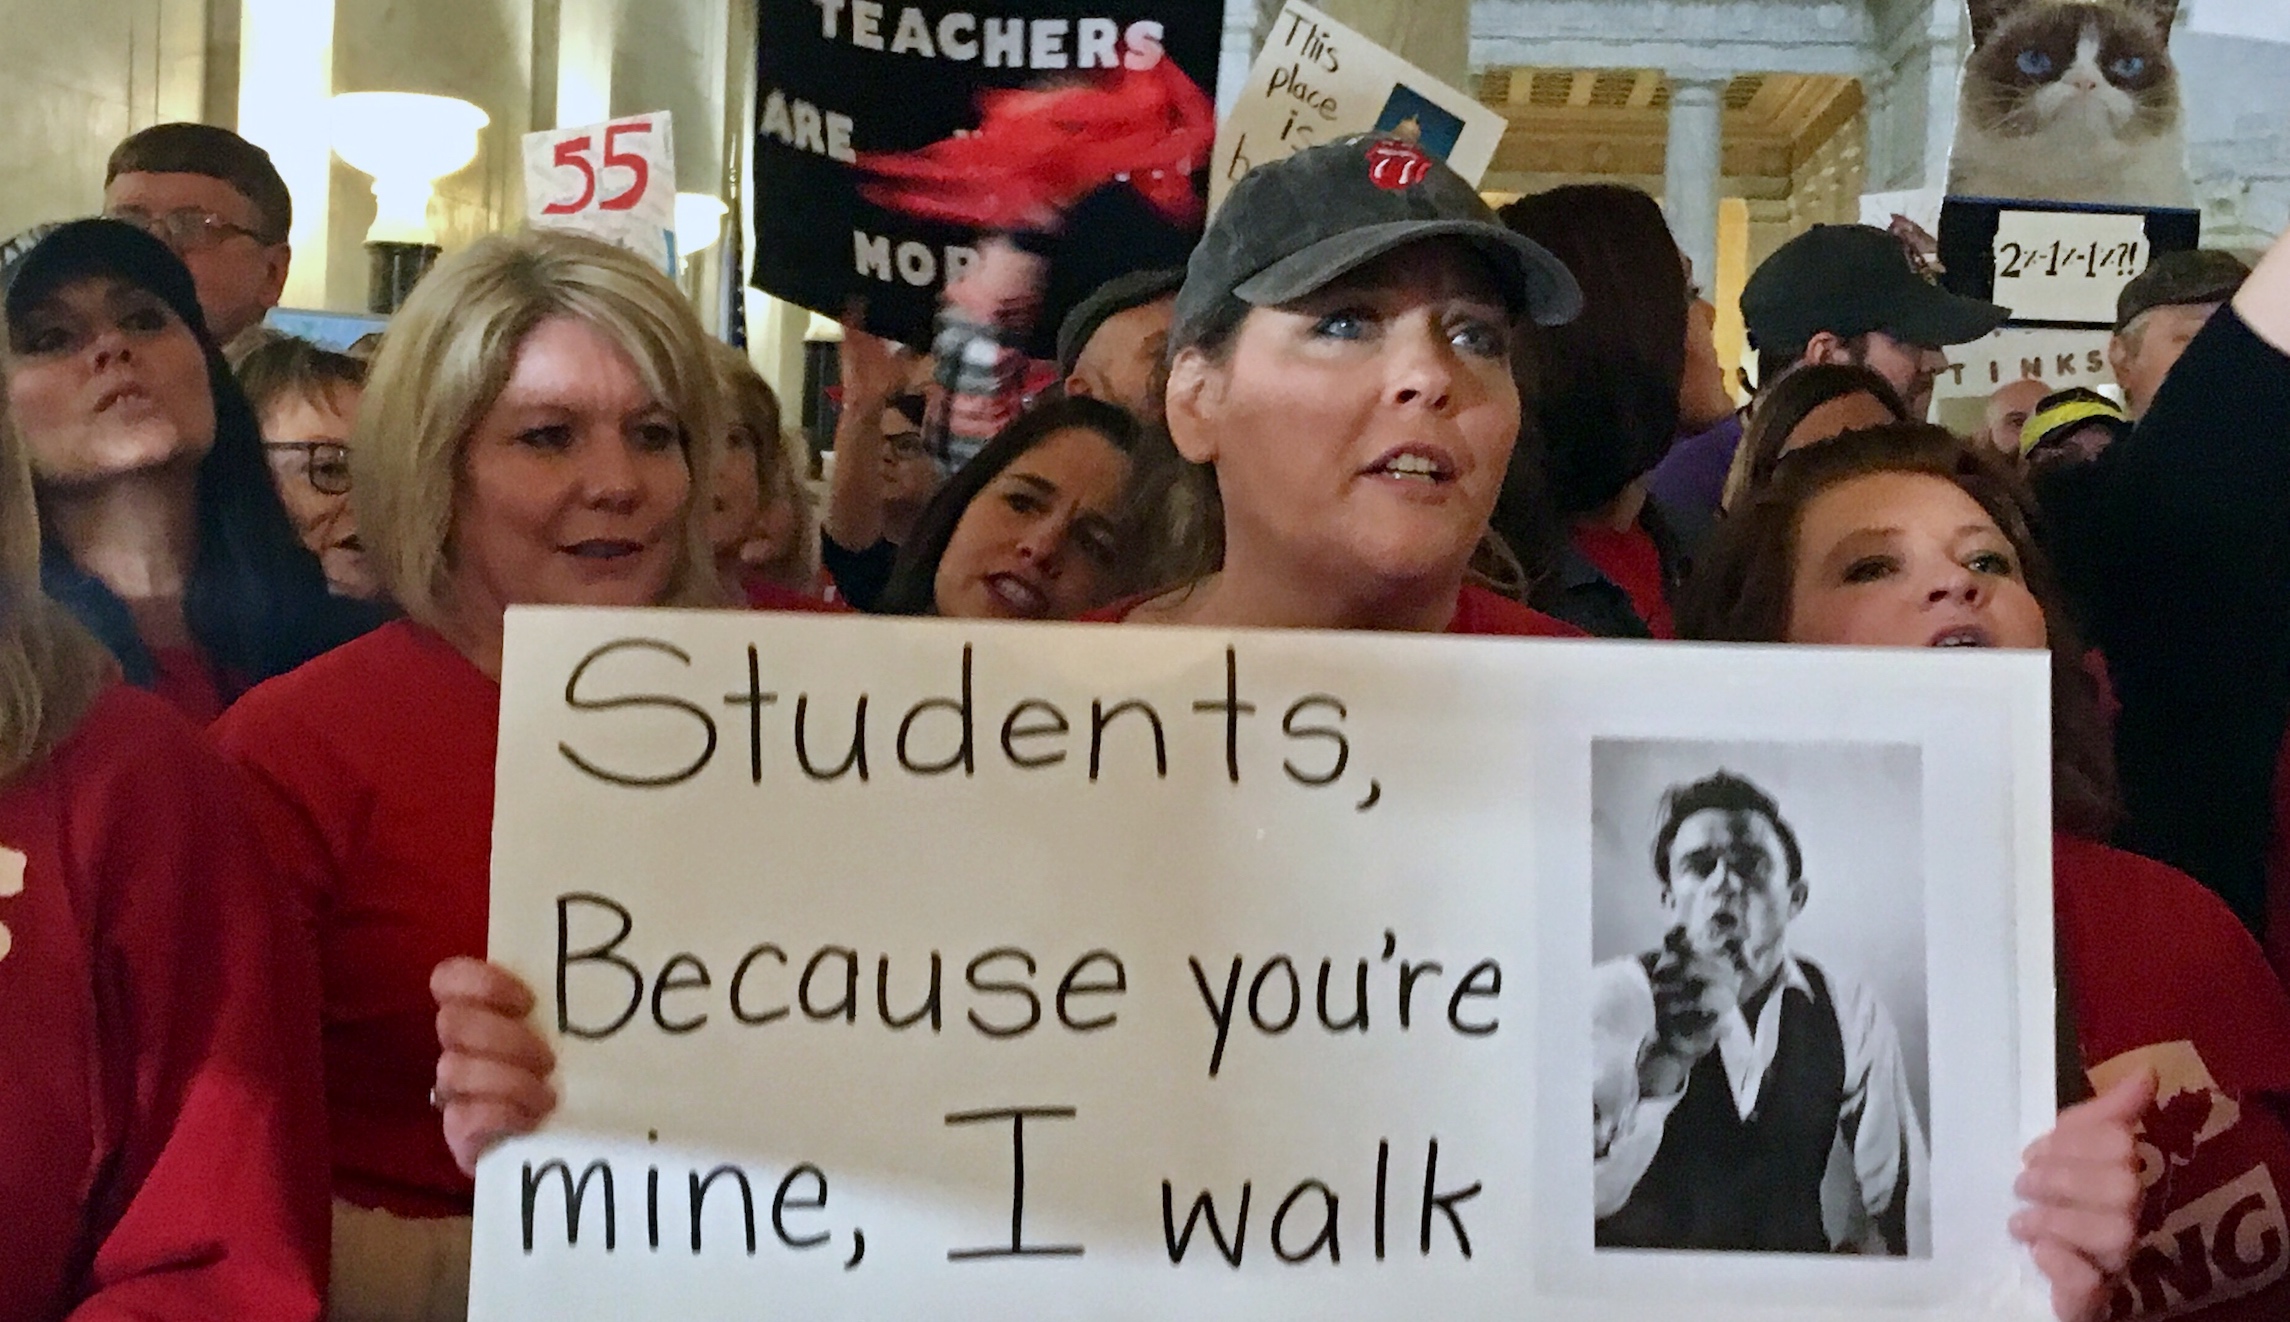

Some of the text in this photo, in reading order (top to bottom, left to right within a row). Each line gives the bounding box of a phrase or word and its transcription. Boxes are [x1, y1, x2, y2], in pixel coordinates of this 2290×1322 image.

[812, 0, 1165, 71] TEACHERS
[1284, 8, 1339, 73] This
[758, 88, 857, 164] ARE
[1266, 63, 1338, 121] place
[541, 123, 653, 215] 55
[1949, 350, 2103, 385] TINKS
[558, 636, 1382, 811] Students,
[556, 892, 1502, 1078] Because you're
[521, 1105, 1482, 1272] mine, I walk
